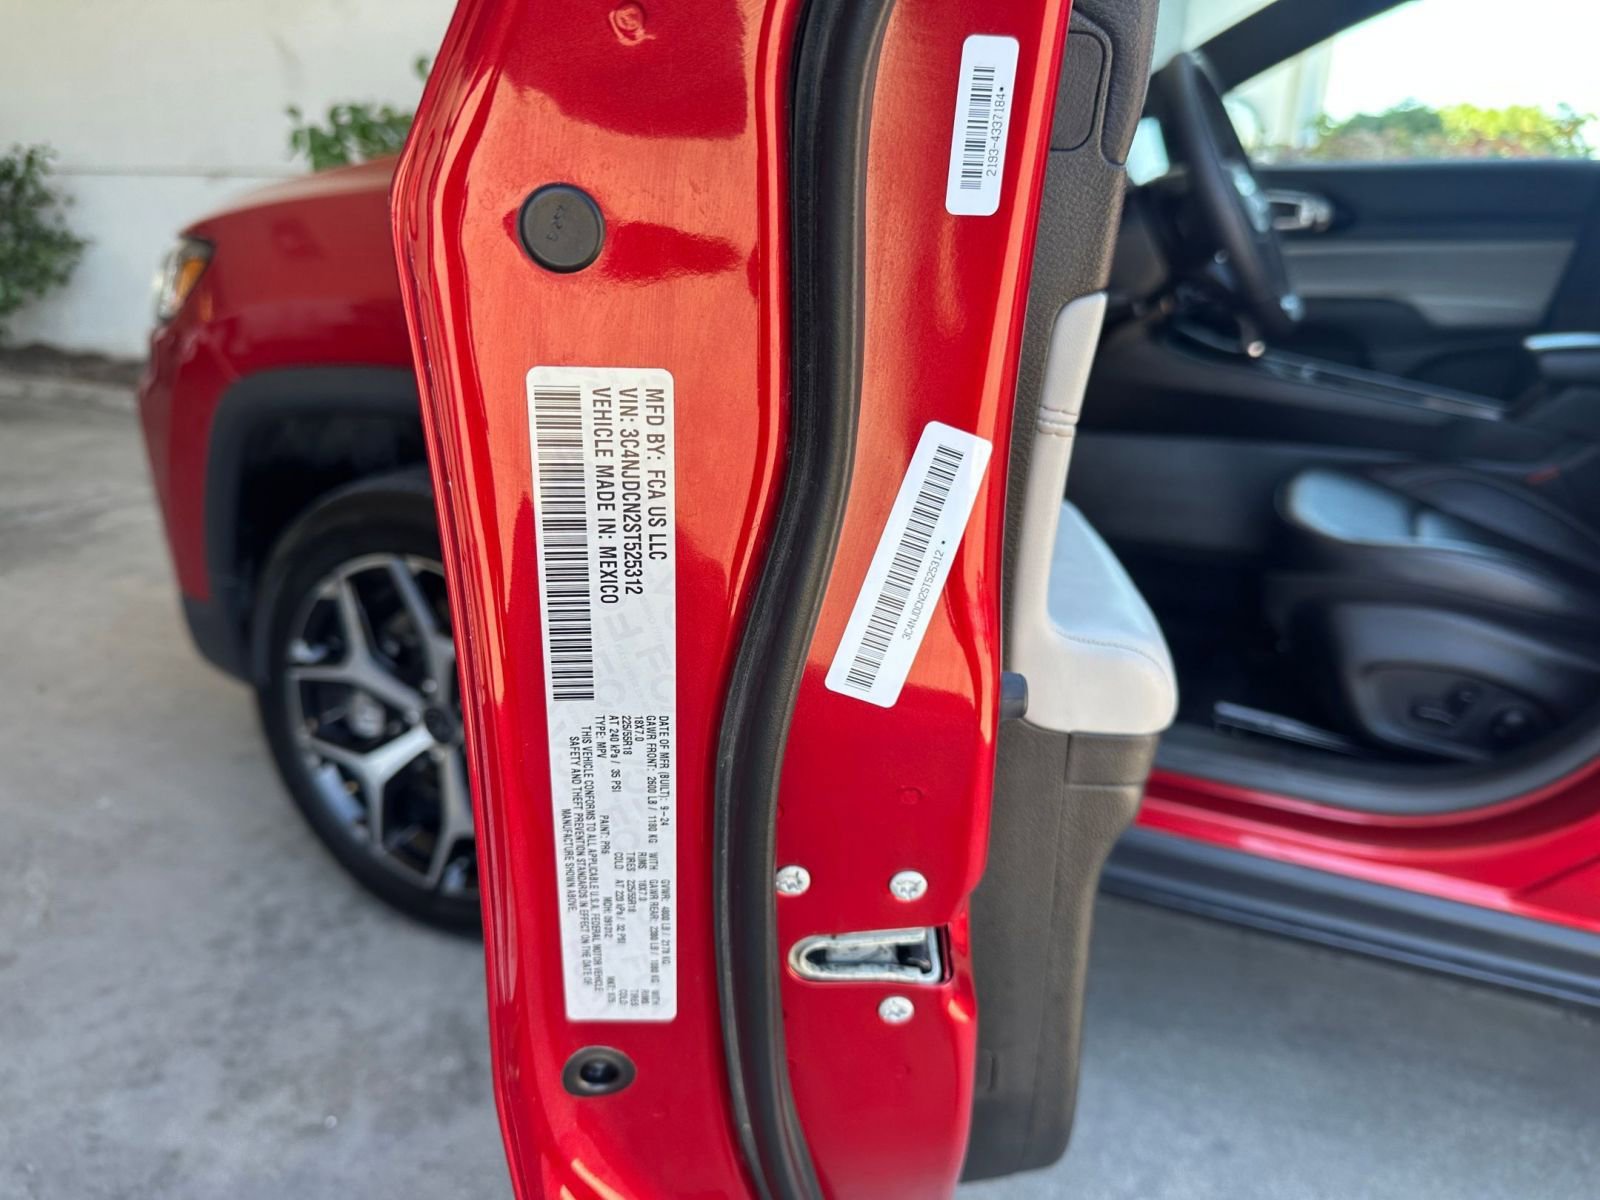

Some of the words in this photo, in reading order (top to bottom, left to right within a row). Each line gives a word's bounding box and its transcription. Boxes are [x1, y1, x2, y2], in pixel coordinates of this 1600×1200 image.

[619, 388, 638, 422] VIN:
[646, 389, 665, 425] MFD
[592, 388, 613, 457] VEHICLE
[647, 434, 665, 460] BY:
[596, 465, 615, 511] MADE
[648, 470, 666, 499] FCA
[620, 429, 643, 594] 3C4NJDCN2ST525312
[648, 507, 667, 527] US
[598, 518, 616, 538] IN:
[649, 534, 667, 560] LLC
[599, 547, 618, 603] MEXICO
[595, 715, 605, 738] TYPE:
[609, 715, 619, 725] AT
[634, 716, 644, 741] 18X7.0
[646, 716, 656, 740] GAWR
[659, 716, 669, 736] DATE
[582, 726, 592, 743] THIS
[610, 729, 619, 741] 240
[622, 716, 632, 755] 225/55R18
[660, 740, 669, 749] OF
[570, 737, 581, 765] SAFETY
[597, 742, 606, 758] MPV
[610, 745, 620, 758] kPa
[647, 743, 657, 771] FRONT:
[660, 752, 669, 768] MFR
[583, 746, 593, 777] VEHICLE
[571, 769, 581, 784] AND
[611, 769, 620, 777] 35
[612, 781, 621, 792] PSI
[647, 776, 657, 793] 2600
[658, 772, 669, 800] (BUILT):
[572, 787, 583, 809] THEFT
[584, 780, 596, 820] CONFORMS
[648, 796, 657, 804] LB
[561, 809, 574, 860] MANUFACTURE
[574, 813, 585, 855] PREVENTION
[587, 823, 596, 832] TO
[600, 815, 609, 838] PAINT:
[587, 834, 597, 846] ALL
[648, 834, 658, 843] KG
[588, 849, 599, 888] APPLICABLE
[614, 852, 624, 869] COLD
[626, 852, 635, 871] TIRES
[638, 852, 647, 869] RIMS
[649, 852, 658, 870] WITH
[565, 863, 575, 887] SHOWN
[577, 858, 588, 898] STANDARDS
[615, 880, 624, 888] AT
[649, 880, 658, 899] GAWR
[579, 910, 589, 932] EFFECT
[591, 914, 601, 942] FEDERAL
[581, 935, 590, 943] ON
[582, 946, 591, 957] THE
[593, 944, 602, 965] MOTOR
[583, 960, 592, 975] DATE
[594, 967, 603, 992] VEHICLE
